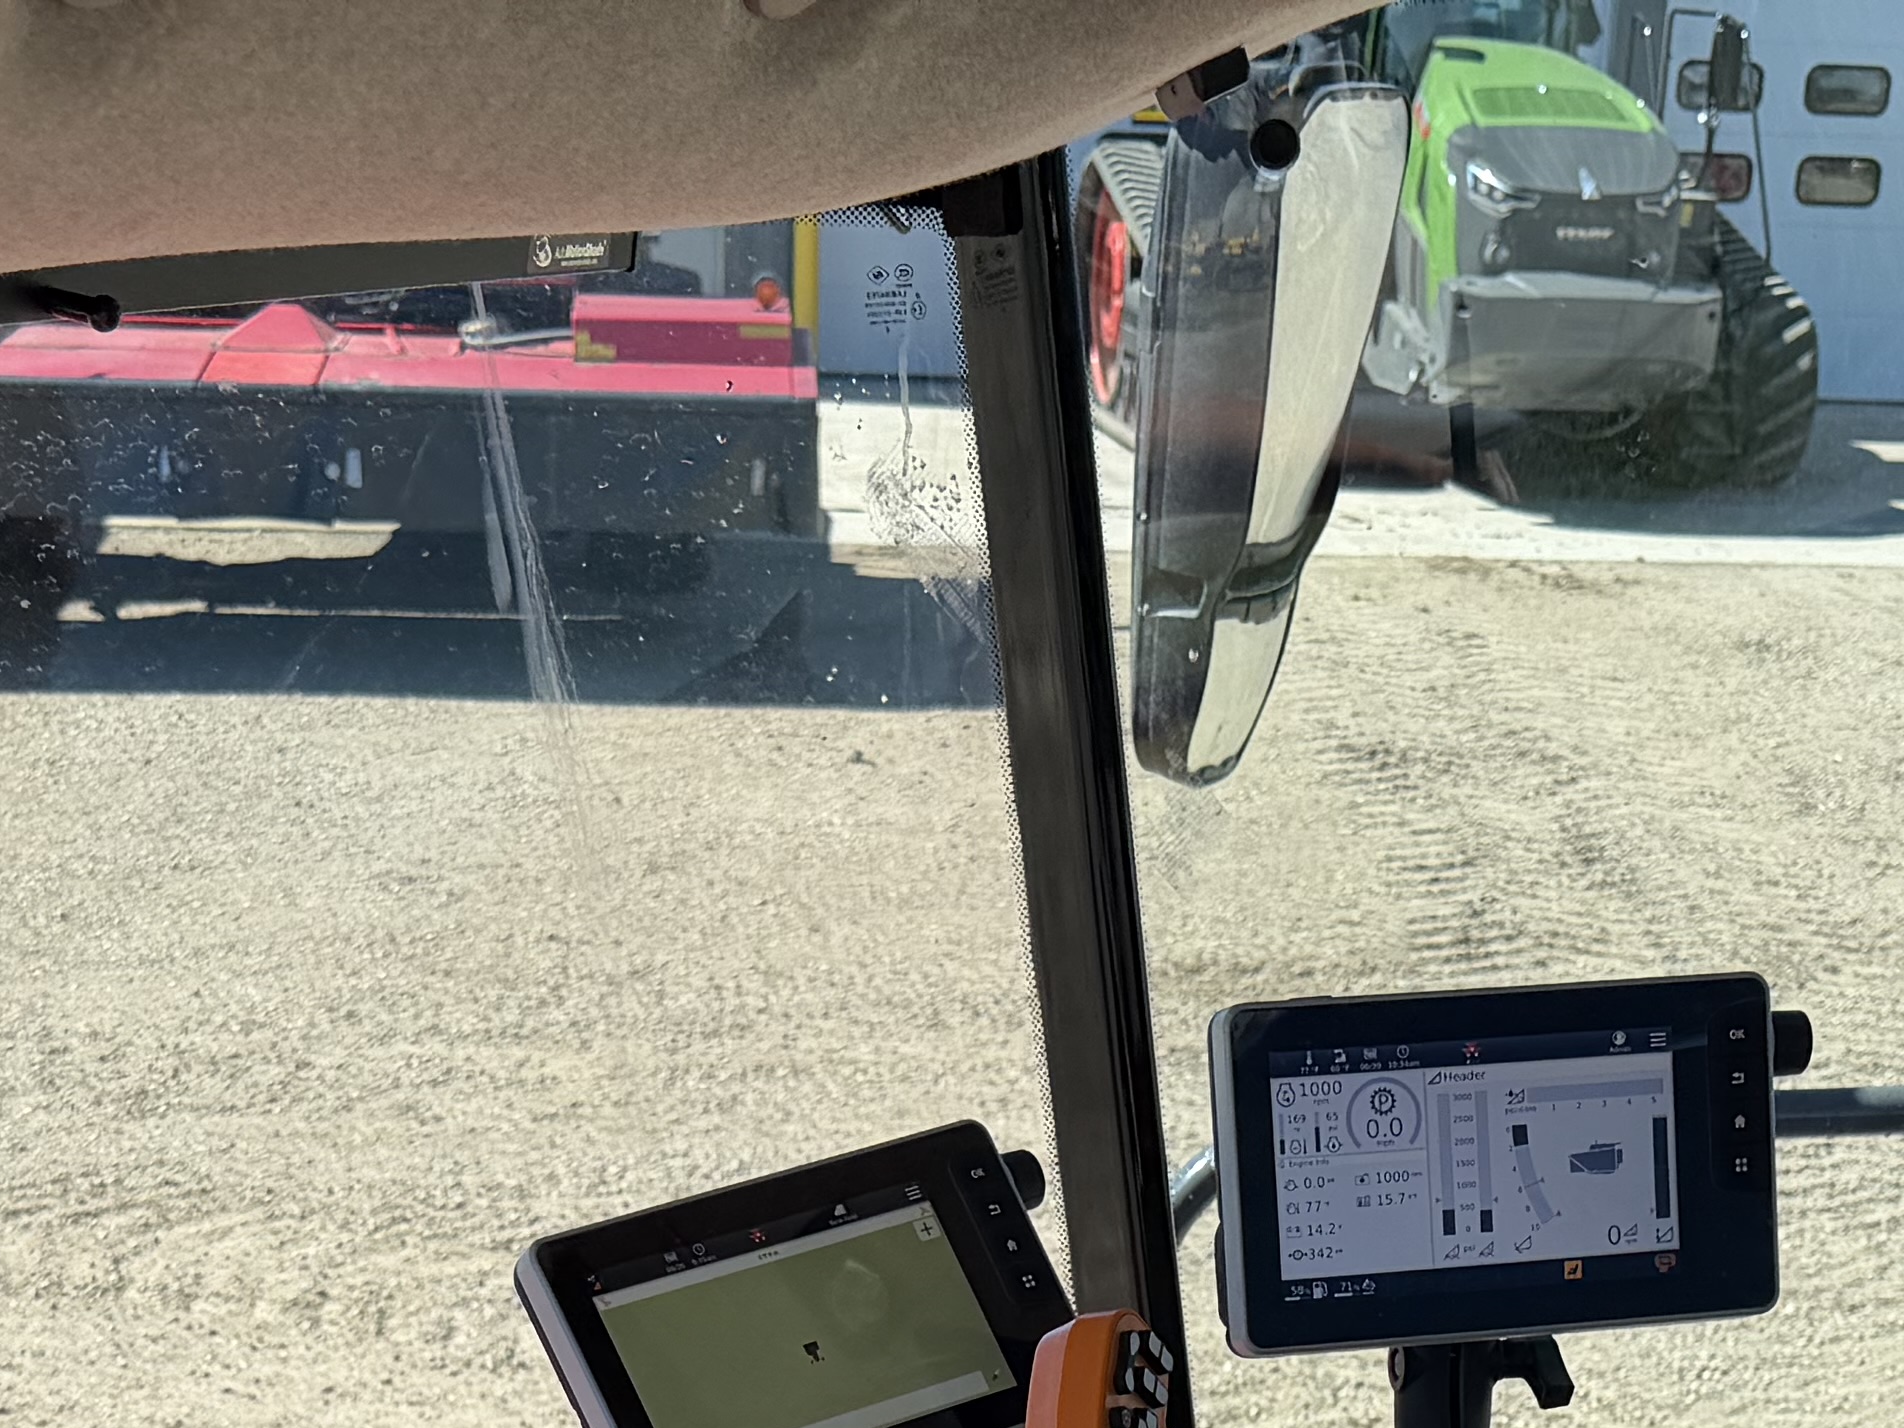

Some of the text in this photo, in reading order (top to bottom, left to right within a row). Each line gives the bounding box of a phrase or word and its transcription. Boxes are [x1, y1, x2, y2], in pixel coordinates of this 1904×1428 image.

[1729, 1029, 1746, 1040] OK
[1444, 1070, 1486, 1083] Header
[1299, 1080, 1343, 1098] 1000
[1287, 1114, 1306, 1124] 169
[1326, 1112, 1339, 1122] 65
[1453, 1115, 1474, 1124] 2500
[1366, 1117, 1403, 1139] 0.0
[1303, 1176, 1325, 1189] 0.0
[1376, 1170, 1410, 1184] 1000
[1377, 1192, 1405, 1207] 15.7
[1305, 1201, 1321, 1213] 77
[1307, 1222, 1337, 1237] 14.2
[1608, 1225, 1621, 1245] 0
[1308, 1246, 1333, 1260] 342
[1340, 1281, 1352, 1291] 71
